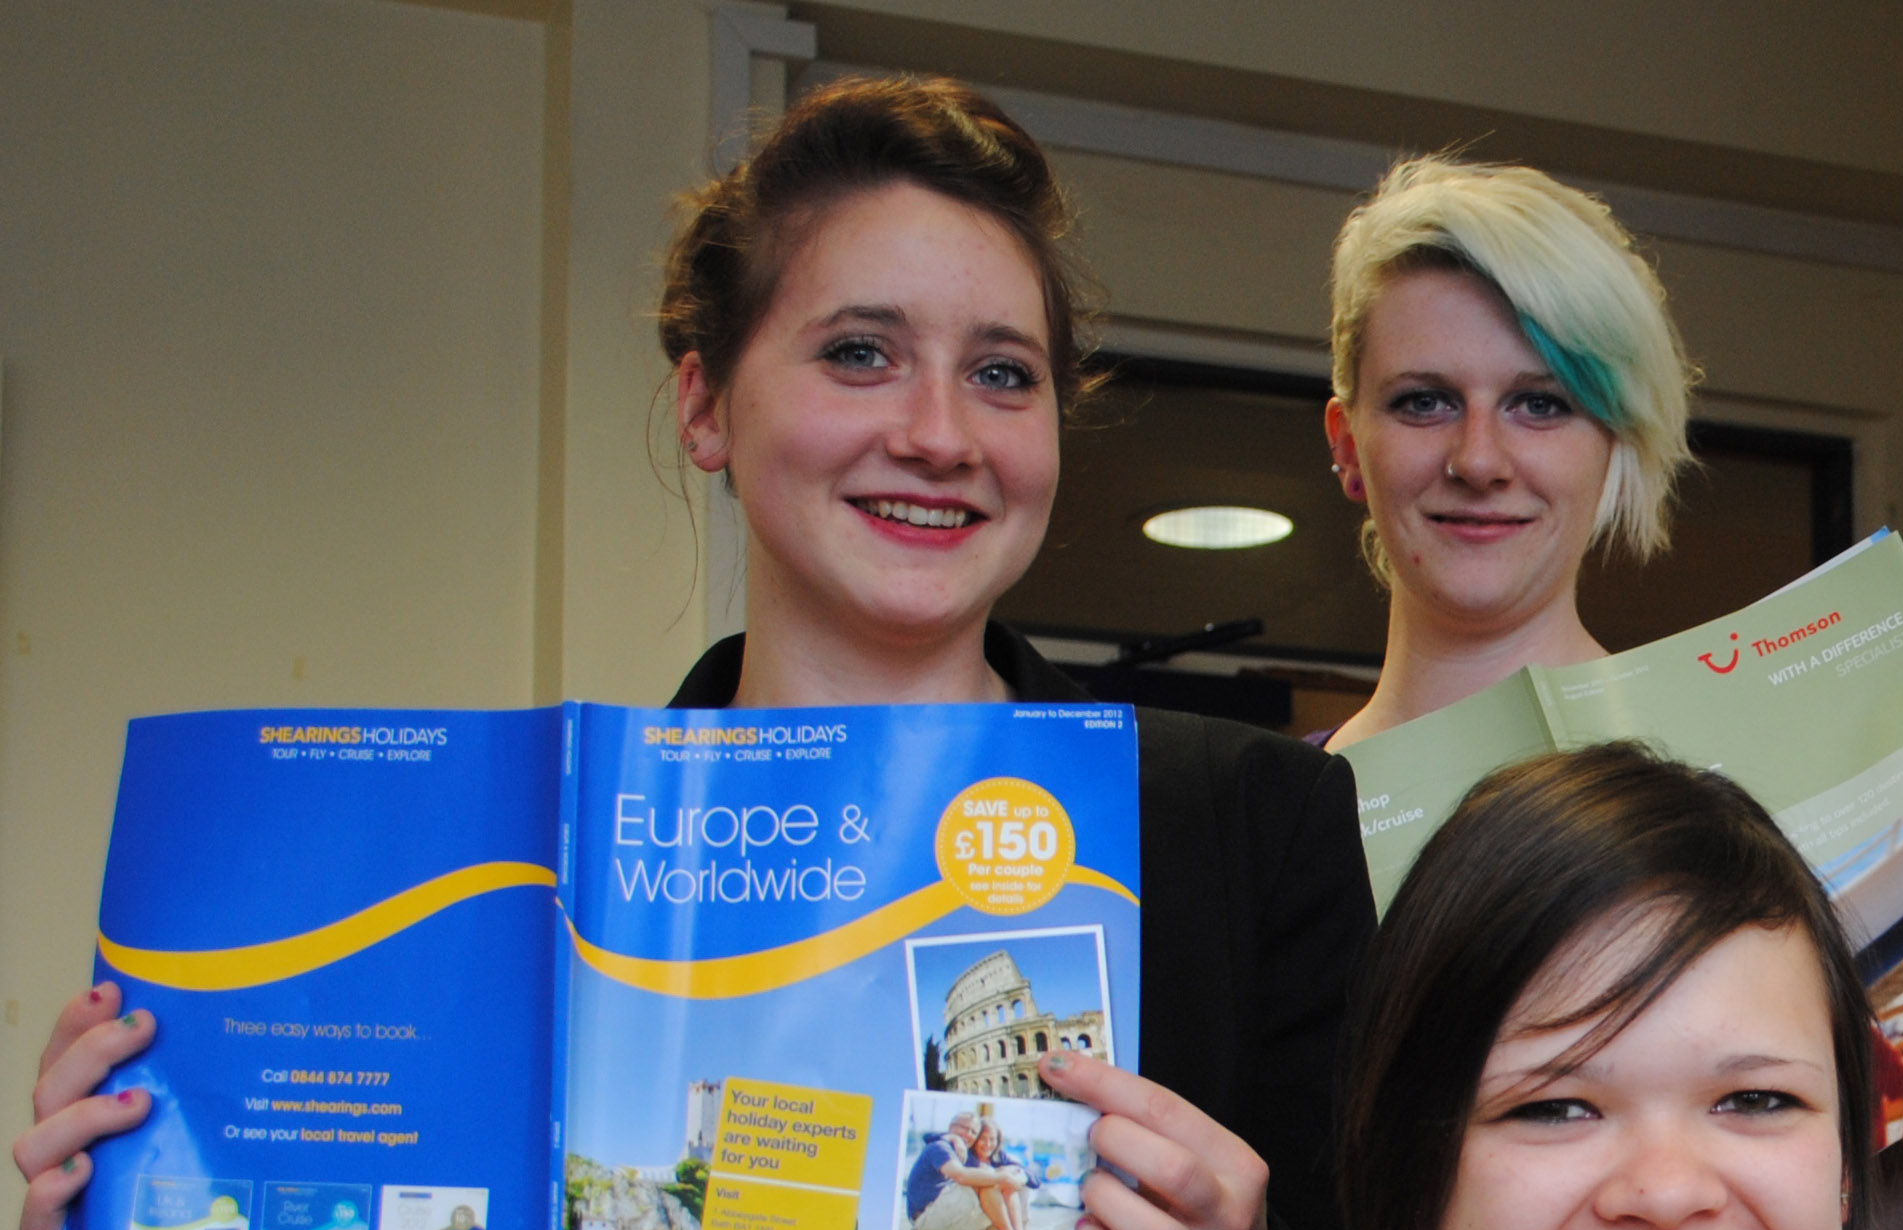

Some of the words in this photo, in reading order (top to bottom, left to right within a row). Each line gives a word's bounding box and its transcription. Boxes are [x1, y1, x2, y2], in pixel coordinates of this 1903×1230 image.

[1752, 611, 1842, 659] Thomson
[1768, 659, 1808, 687] WITH
[1809, 654, 1821, 669] A
[964, 800, 1008, 817] SAVE
[1014, 807, 1032, 819] up
[1036, 806, 1049, 817] to
[615, 794, 819, 857] Europe
[839, 805, 870, 844] &
[955, 821, 1057, 861] £150
[615, 858, 867, 904] Worldwide
[968, 863, 990, 876] Per
[995, 863, 1043, 877] couple
[224, 1018, 266, 1035] Three
[272, 1021, 309, 1039] easy
[314, 1023, 351, 1040] ways
[356, 1024, 372, 1039] to
[262, 1069, 288, 1083] Call
[290, 1070, 324, 1084] 0844
[328, 1071, 352, 1085] 874
[357, 1072, 390, 1086] 7777
[245, 1097, 269, 1111] Visit
[272, 1099, 402, 1117] www.shearings.com
[731, 1088, 770, 1108] Your
[773, 1095, 814, 1114] local
[225, 1125, 240, 1139] Or
[243, 1127, 267, 1139] see
[271, 1129, 298, 1142] your
[301, 1128, 334, 1142] local
[338, 1129, 375, 1143] travel
[378, 1131, 419, 1147] agent
[727, 1110, 788, 1134] holiday
[792, 1122, 856, 1140] experts
[724, 1131, 750, 1147] are
[756, 1136, 818, 1158] waiting
[721, 1148, 743, 1164] for
[749, 1153, 780, 1170] you
[716, 1186, 740, 1200] Visit
